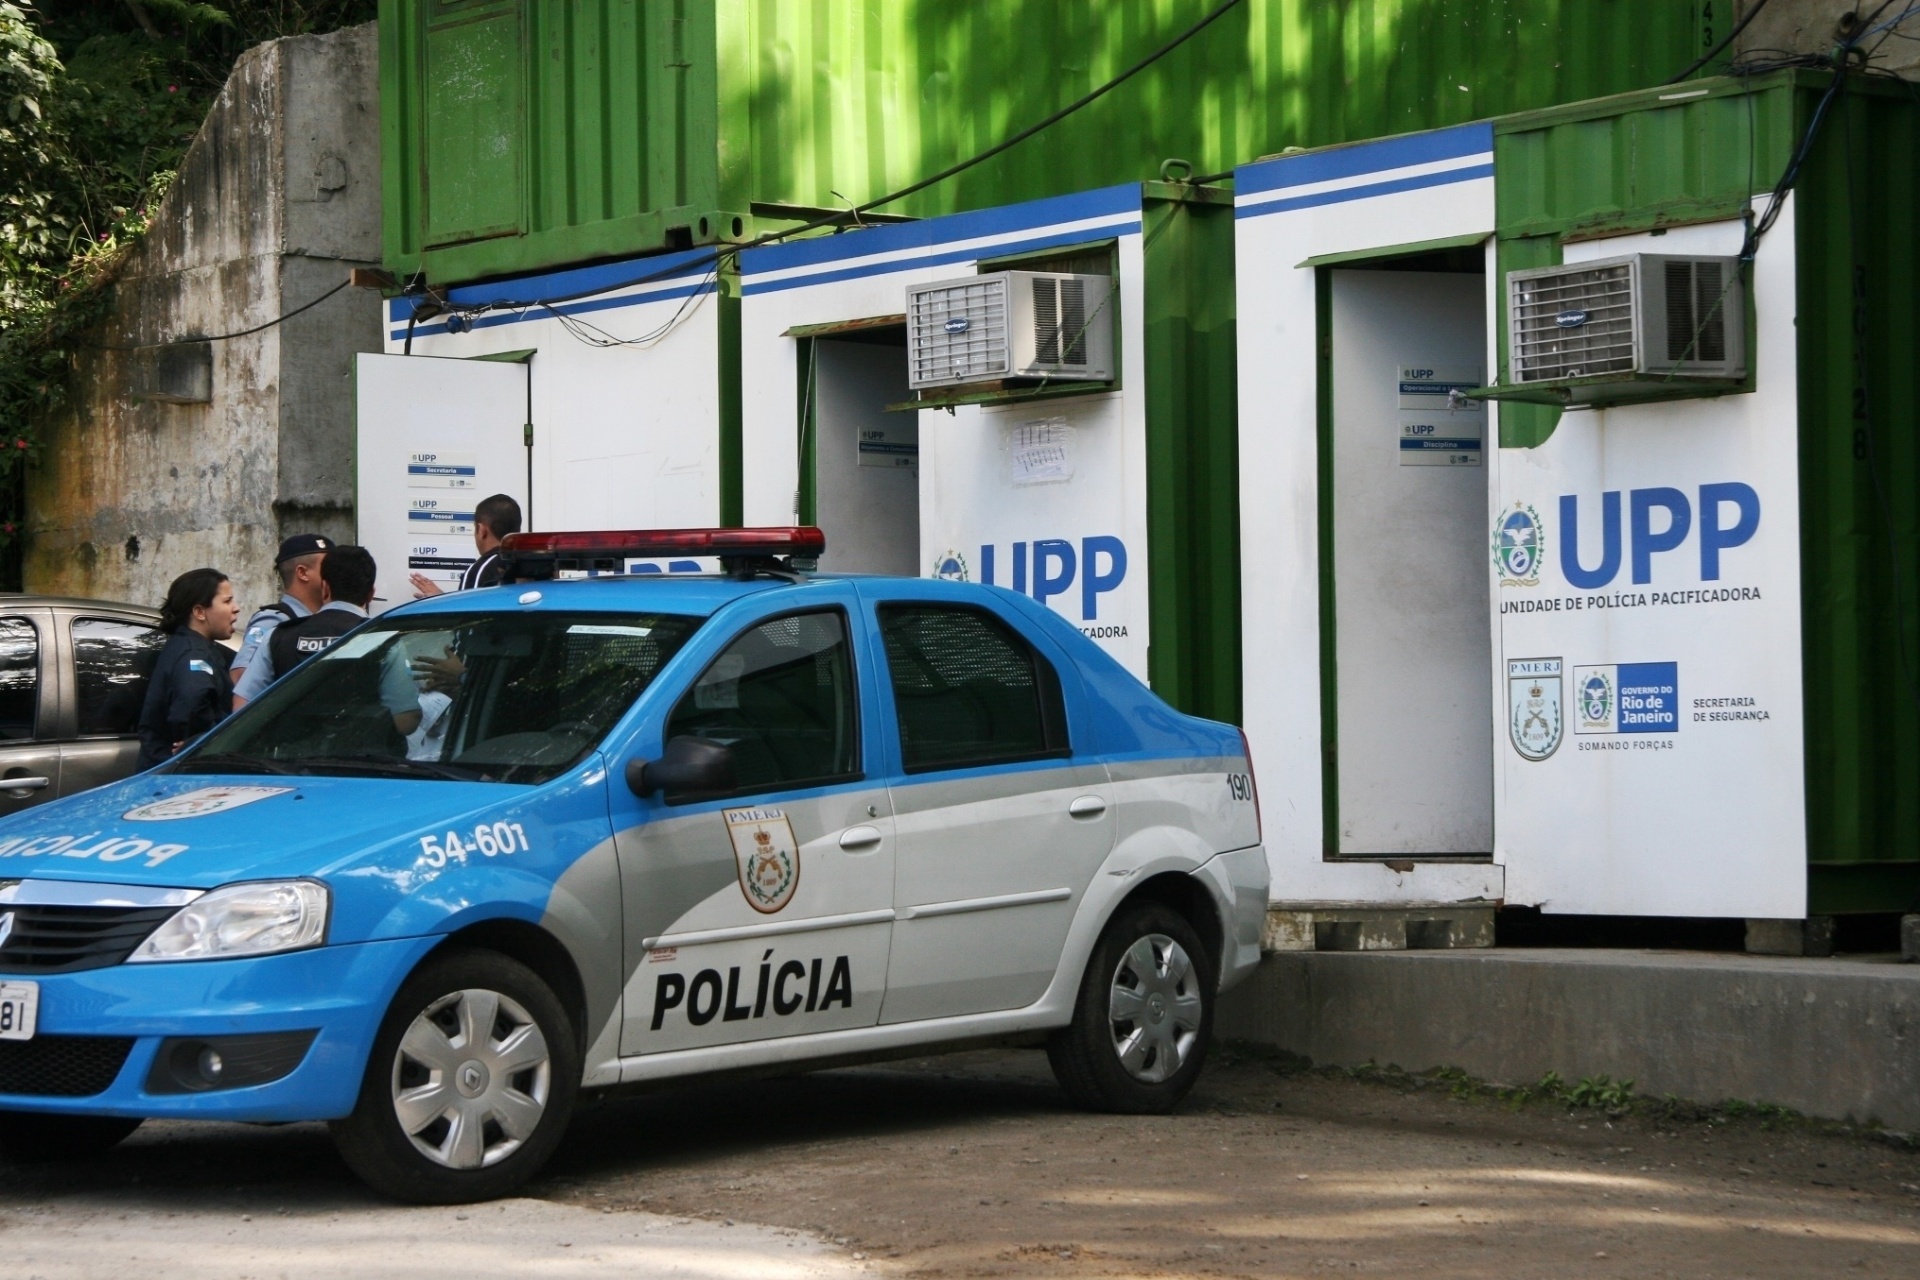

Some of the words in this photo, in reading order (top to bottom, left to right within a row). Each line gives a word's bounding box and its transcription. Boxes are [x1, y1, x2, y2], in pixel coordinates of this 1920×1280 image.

[1411, 369, 1434, 379] UPP
[867, 431, 885, 440] UPP
[1412, 425, 1435, 435] UPP
[1423, 441, 1458, 449] Disciplina
[418, 454, 437, 462] UPP
[1559, 481, 1761, 590] UPP
[418, 547, 438, 555] UPP
[1500, 599, 1561, 614] UNIDADE
[1565, 597, 1583, 610] DE
[1587, 590, 1647, 609] POLÍCIA
[1651, 586, 1762, 606] PACIFICADORA
[1078, 625, 1129, 639] CADORA
[298, 637, 333, 652] POLÍ
[1510, 662, 1560, 673] PMERJ
[1621, 686, 1659, 695] GOVERNO
[1660, 686, 1673, 694] DO
[1621, 696, 1644, 710] Rio
[1645, 695, 1664, 709] de
[1692, 697, 1756, 708] SECRETARIA
[1621, 709, 1674, 724] Janeiro
[1693, 712, 1706, 722] DE
[1708, 710, 1770, 723] SEGURANÇA
[1528, 733, 1544, 741] 1809
[1578, 741, 1629, 751] SOMANDO
[1632, 740, 1674, 752] FORÇAS
[1226, 773, 1252, 801] 190
[420, 822, 529, 868] 54-601
[650, 948, 852, 1031] POLÍCIA
